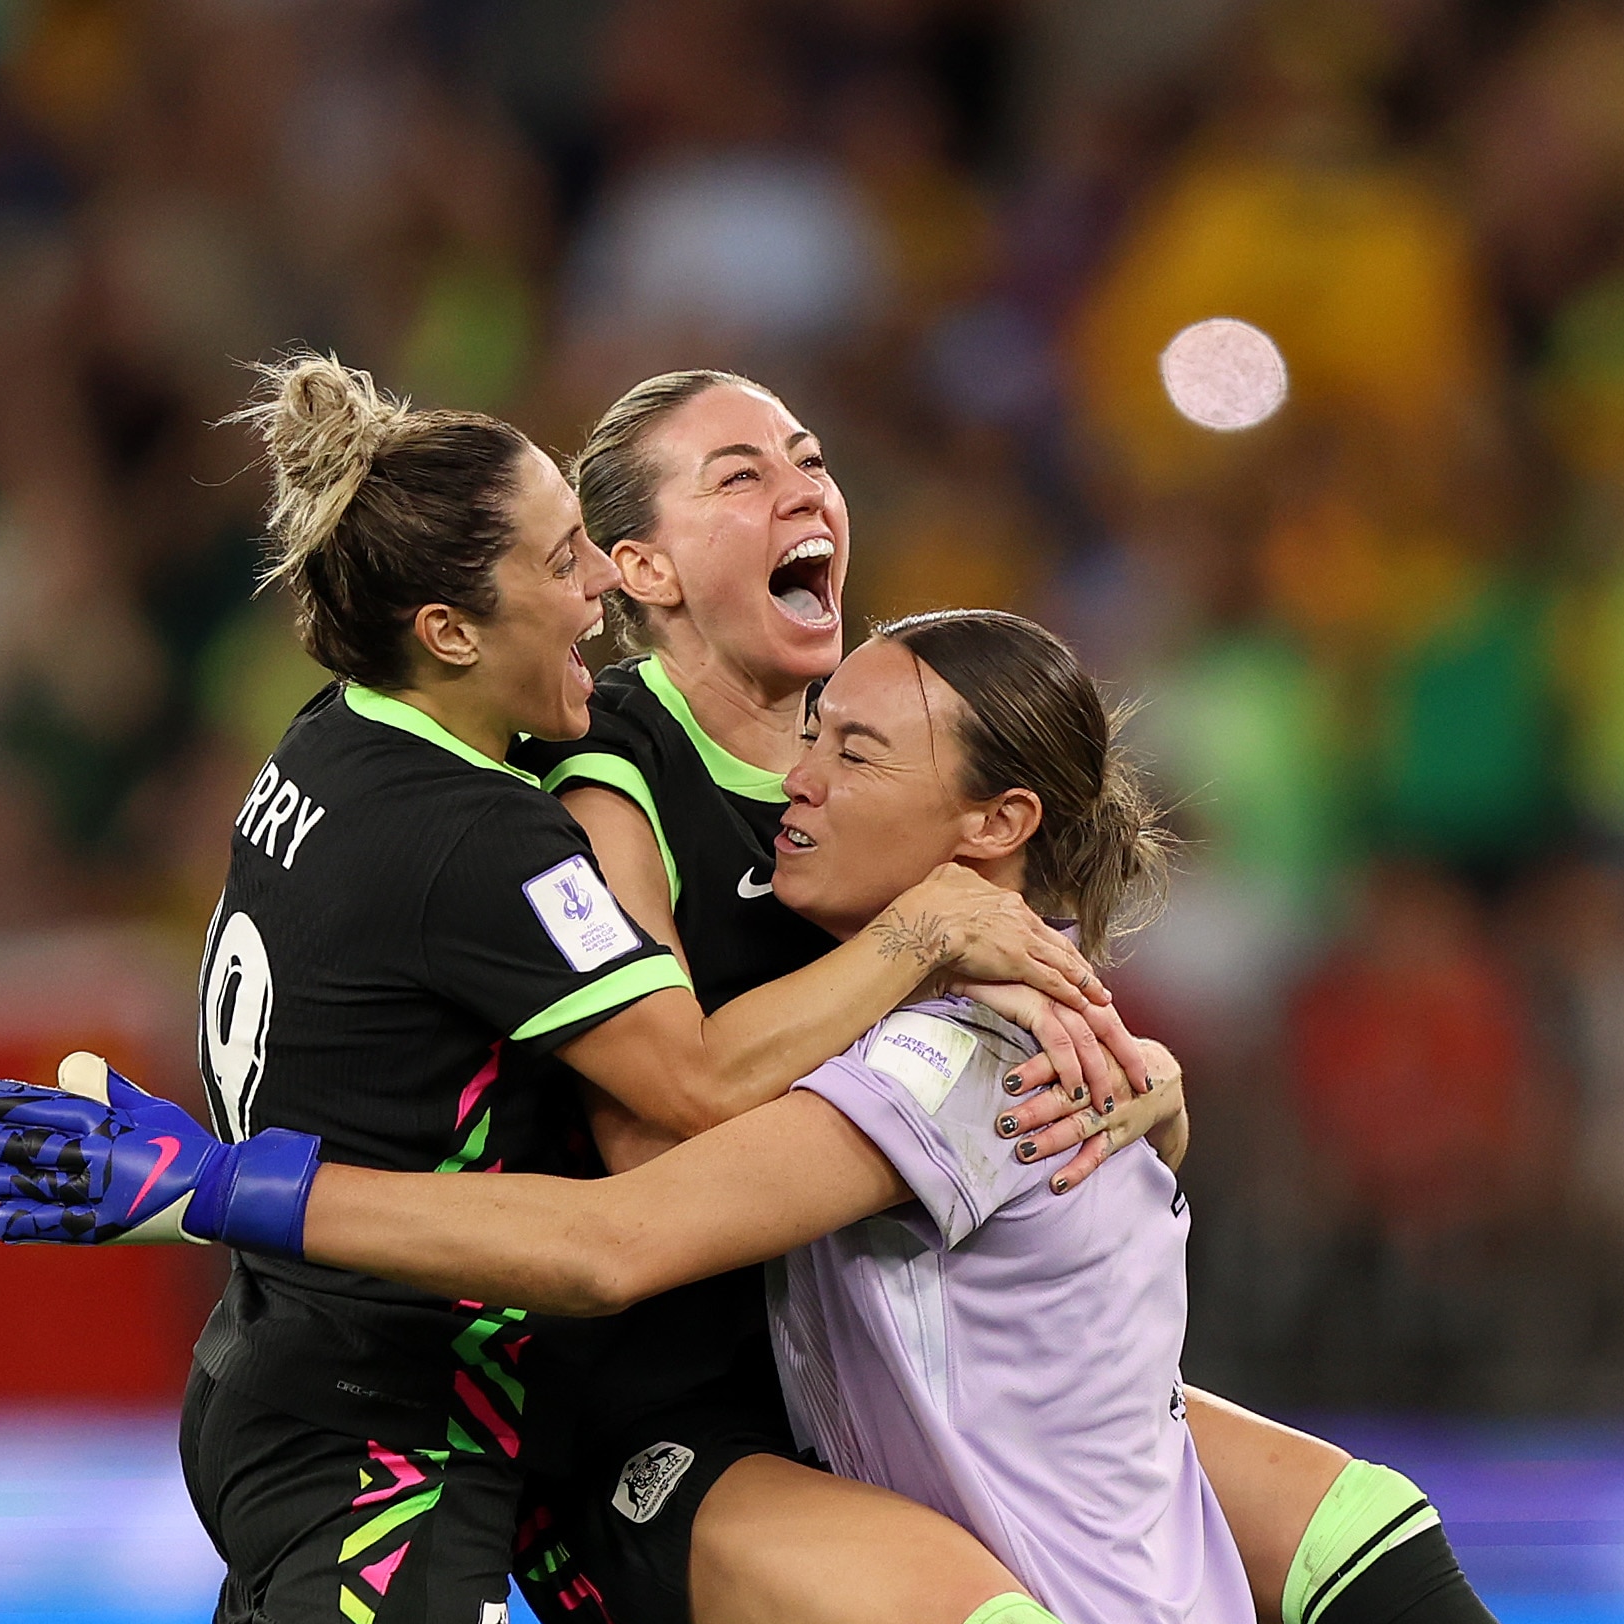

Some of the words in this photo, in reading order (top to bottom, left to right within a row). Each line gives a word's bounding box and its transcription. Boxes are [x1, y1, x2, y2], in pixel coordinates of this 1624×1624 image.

[236, 754, 326, 870] RRY
[581, 933, 602, 948] ASIAN
[601, 926, 614, 939] CUP
[585, 933, 618, 953] AUSTRALIA
[883, 1035, 952, 1079] FEARLESS
[896, 1033, 948, 1065] DREAM
[639, 1458, 683, 1510] AUSTRALIA
